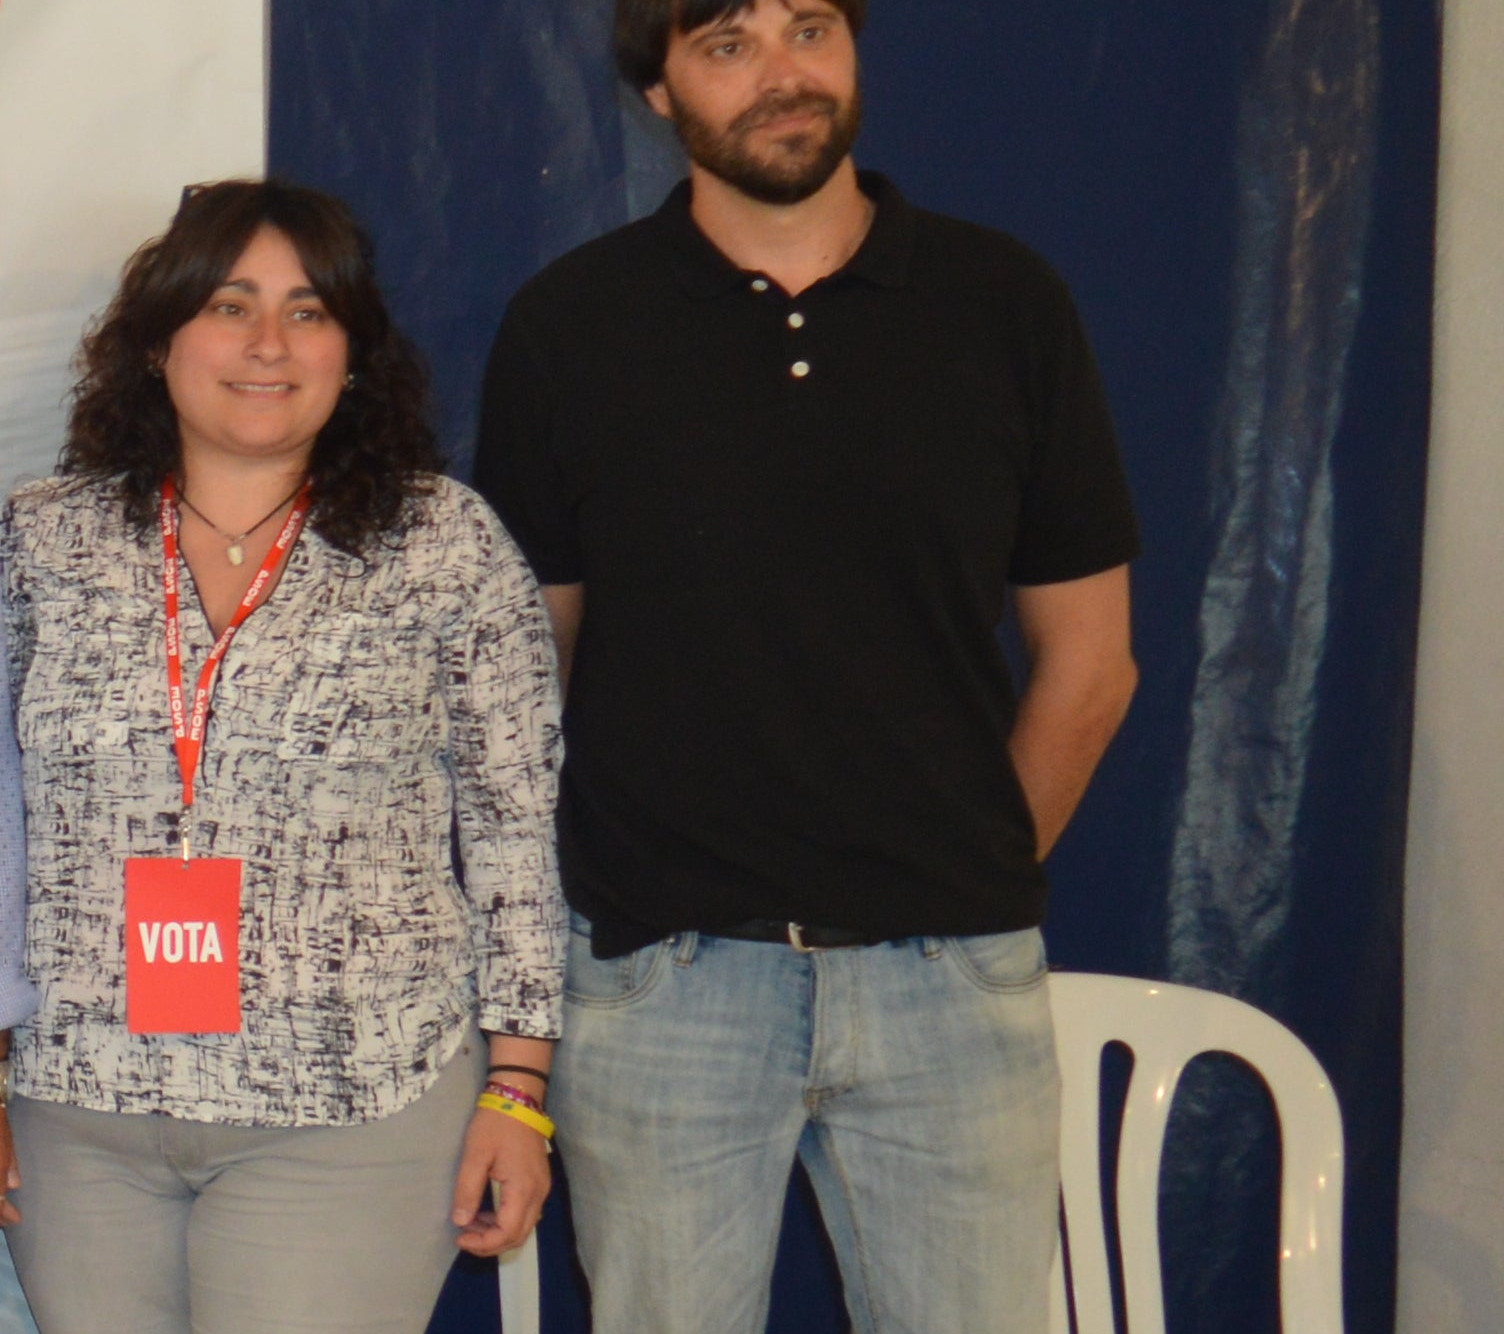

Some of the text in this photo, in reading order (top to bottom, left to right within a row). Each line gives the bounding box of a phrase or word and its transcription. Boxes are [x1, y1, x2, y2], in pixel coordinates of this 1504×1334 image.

[243, 570, 269, 606] PSOE
[170, 686, 185, 738] PSOE
[190, 689, 206, 741] PSOE
[138, 922, 224, 963] VOTA
